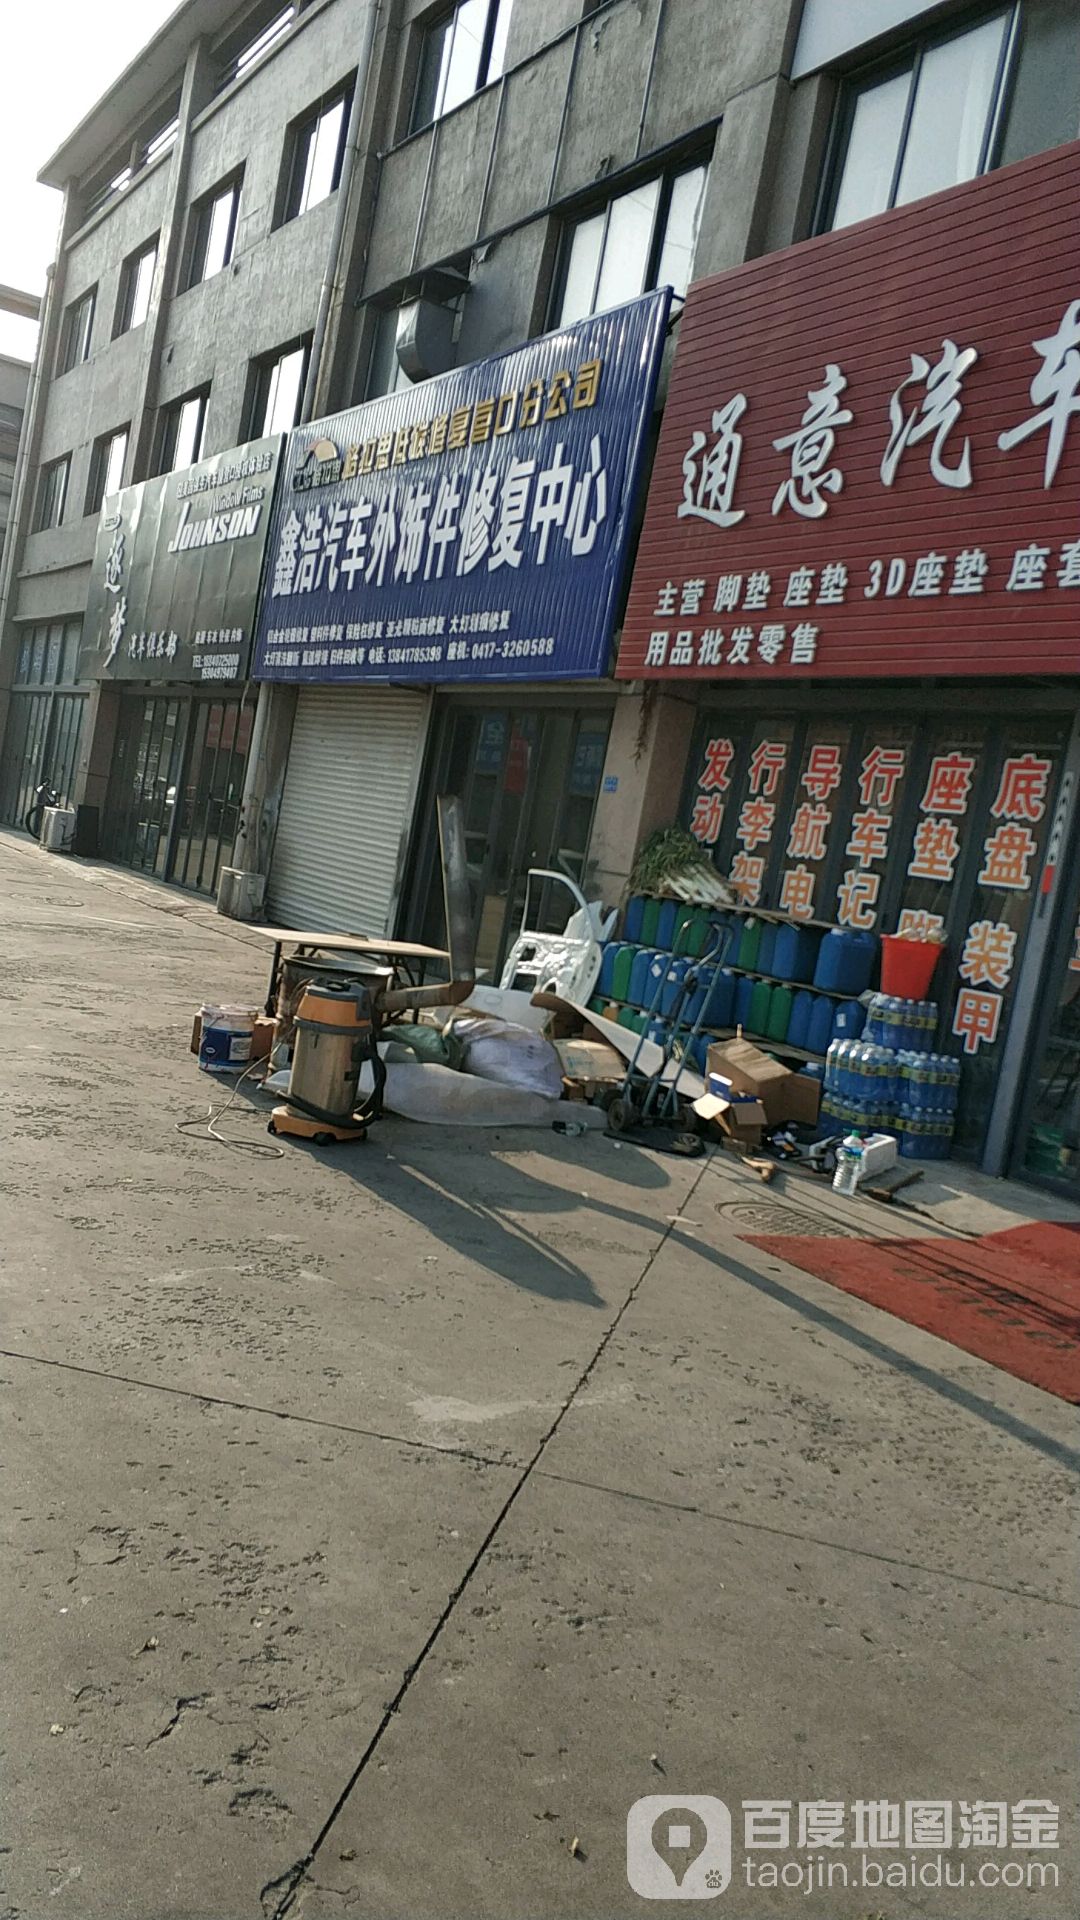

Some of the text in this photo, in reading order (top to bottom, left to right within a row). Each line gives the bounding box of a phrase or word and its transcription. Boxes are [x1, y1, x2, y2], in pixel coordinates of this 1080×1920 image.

[242, 486, 264, 504] Films
[676, 299, 1080, 529] 通意汽车
[272, 433, 607, 599] 鑫浩汽车外饰件修复中心
[653, 580, 706, 617] 主营
[712, 570, 773, 613] 脚垫
[782, 564, 849, 608] 座垫
[864, 549, 989, 600] 3D座垫
[128, 630, 178, 664] 汽车俱乐部
[643, 623, 819, 667] 用品批发零售
[727, 740, 787, 907] 行李架
[780, 745, 842, 920] 导航电
[837, 745, 905, 930] 行车记
